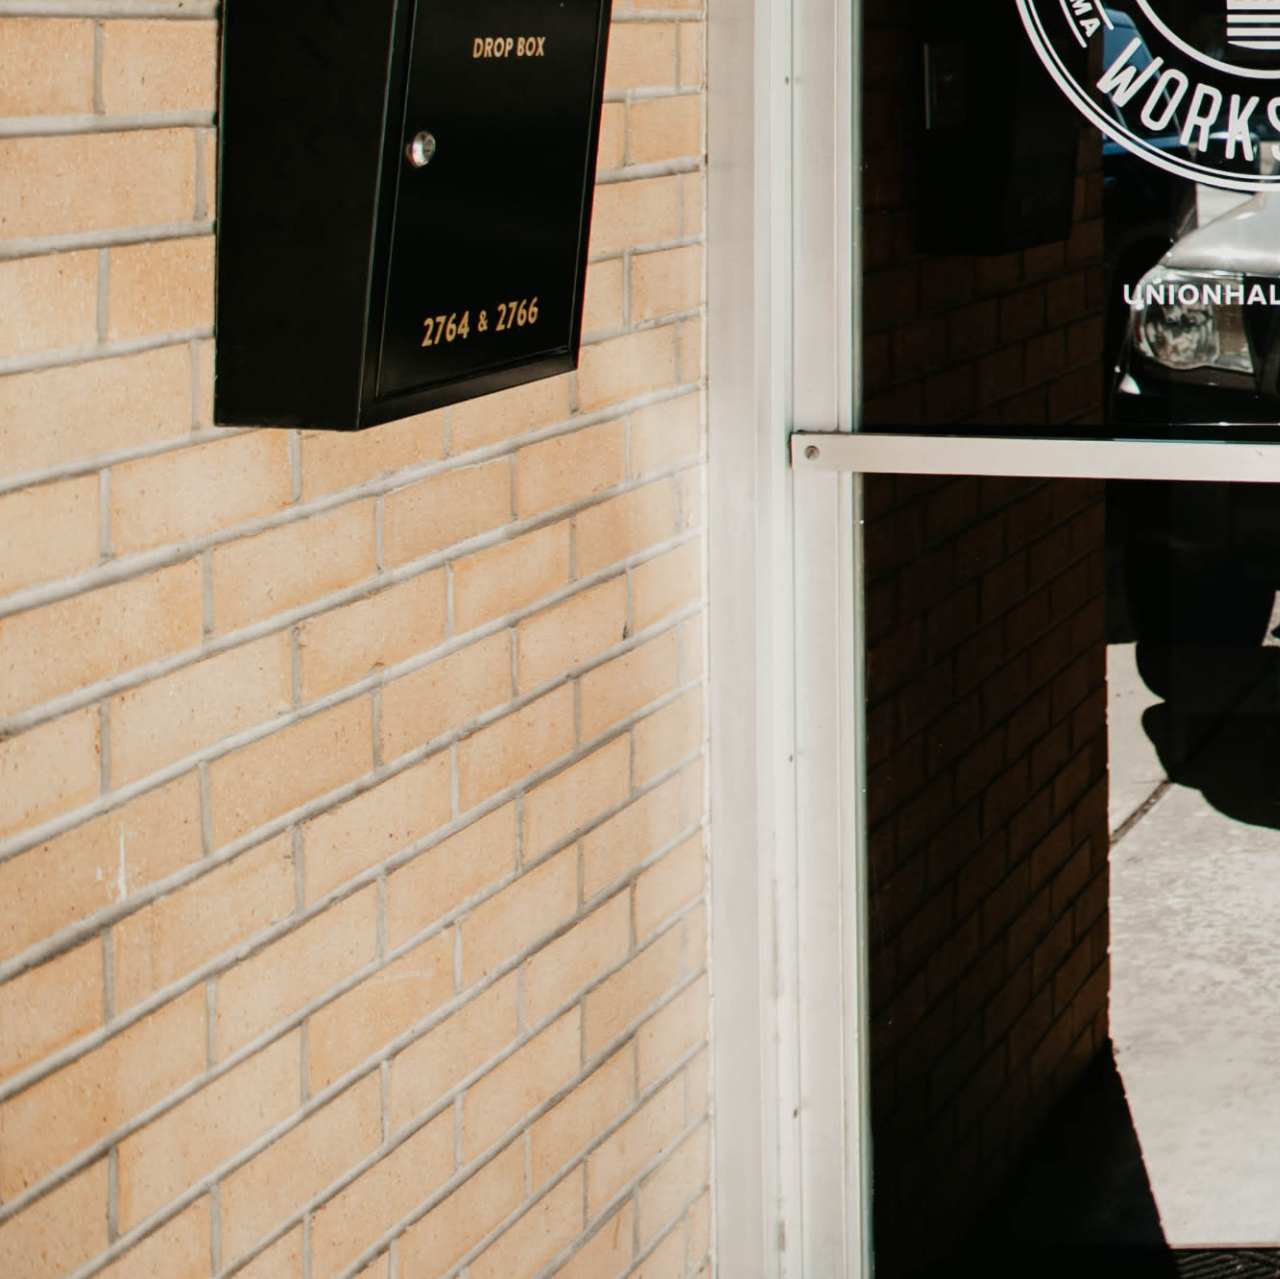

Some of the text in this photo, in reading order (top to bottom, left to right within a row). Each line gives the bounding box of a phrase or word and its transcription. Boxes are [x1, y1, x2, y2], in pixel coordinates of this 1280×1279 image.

[472, 36, 546, 58] DROP BOX
[421, 296, 539, 347] 2764 & 2766
